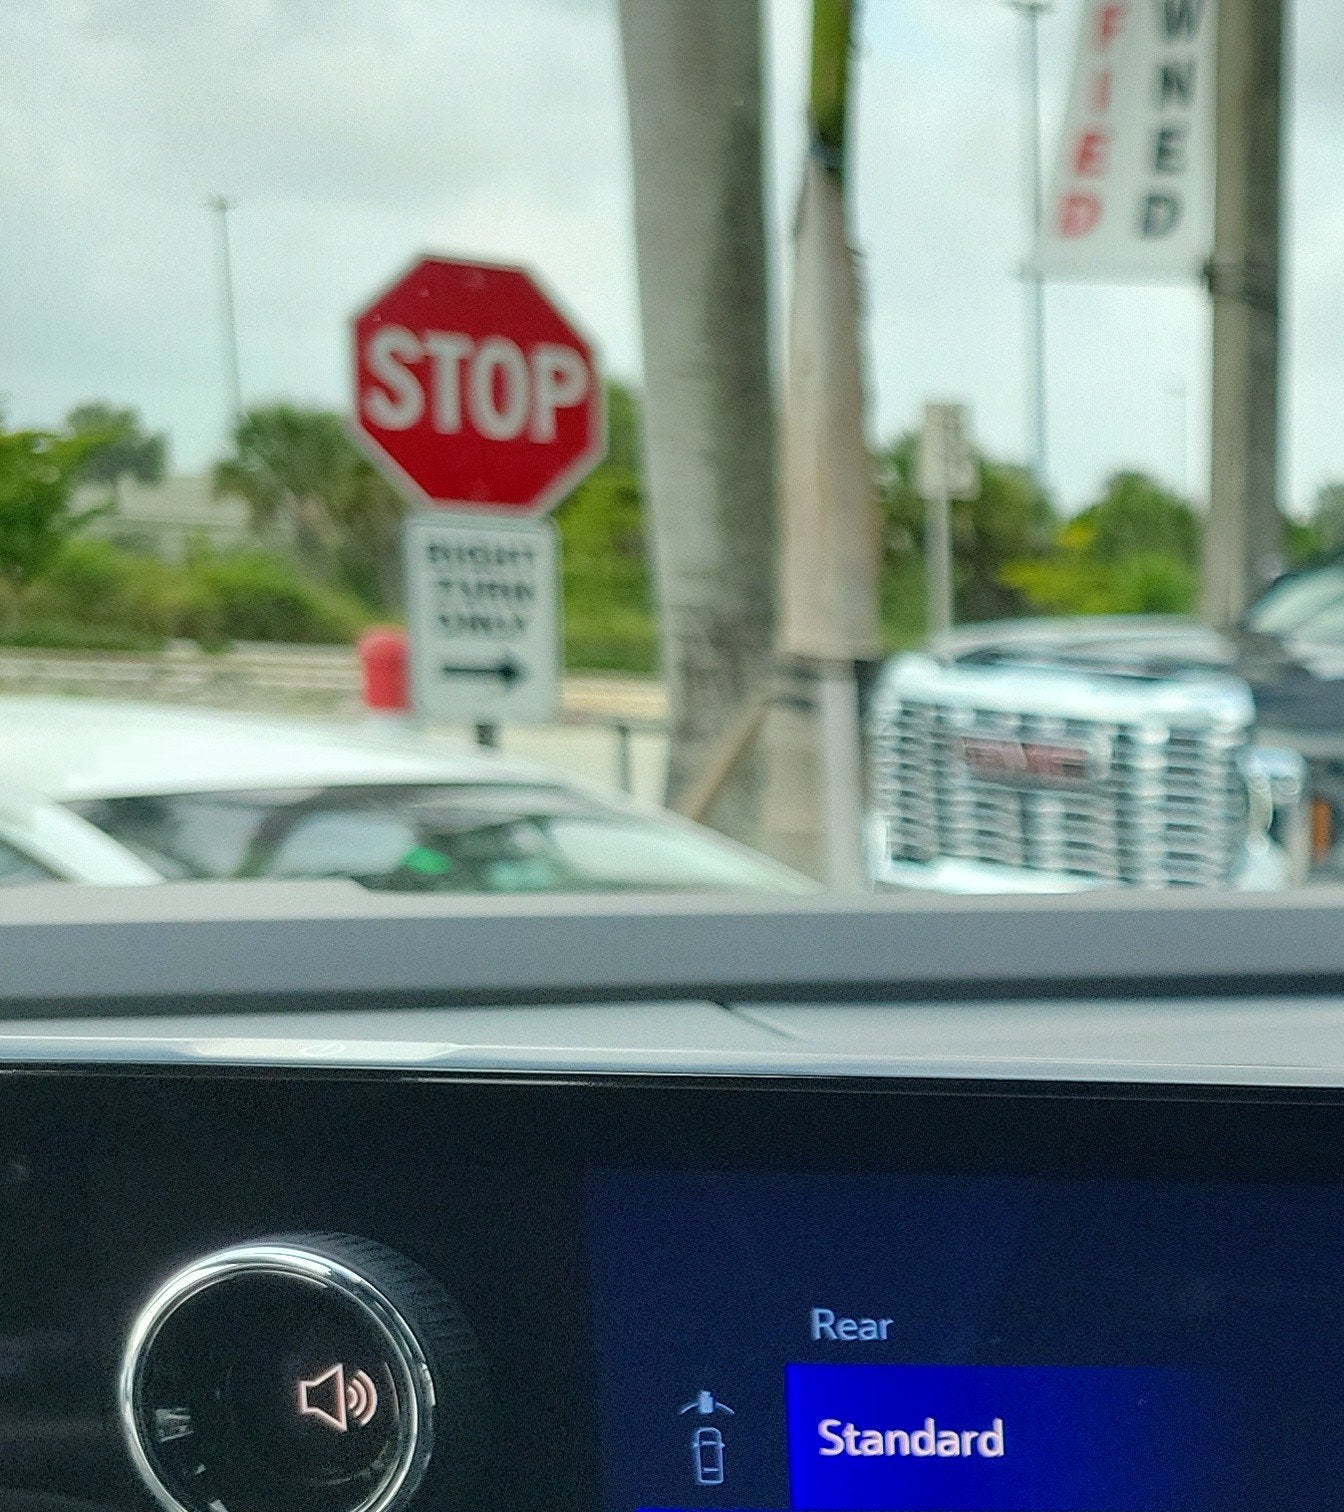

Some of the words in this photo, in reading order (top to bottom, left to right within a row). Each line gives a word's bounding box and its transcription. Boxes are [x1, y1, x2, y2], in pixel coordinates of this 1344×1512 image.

[361, 325, 590, 445] STOP
[426, 542, 536, 572] RIGHT
[438, 577, 536, 606] TURN
[438, 611, 528, 642] ONLY
[810, 1307, 894, 1341] Rear
[818, 1417, 1005, 1458] Standard
